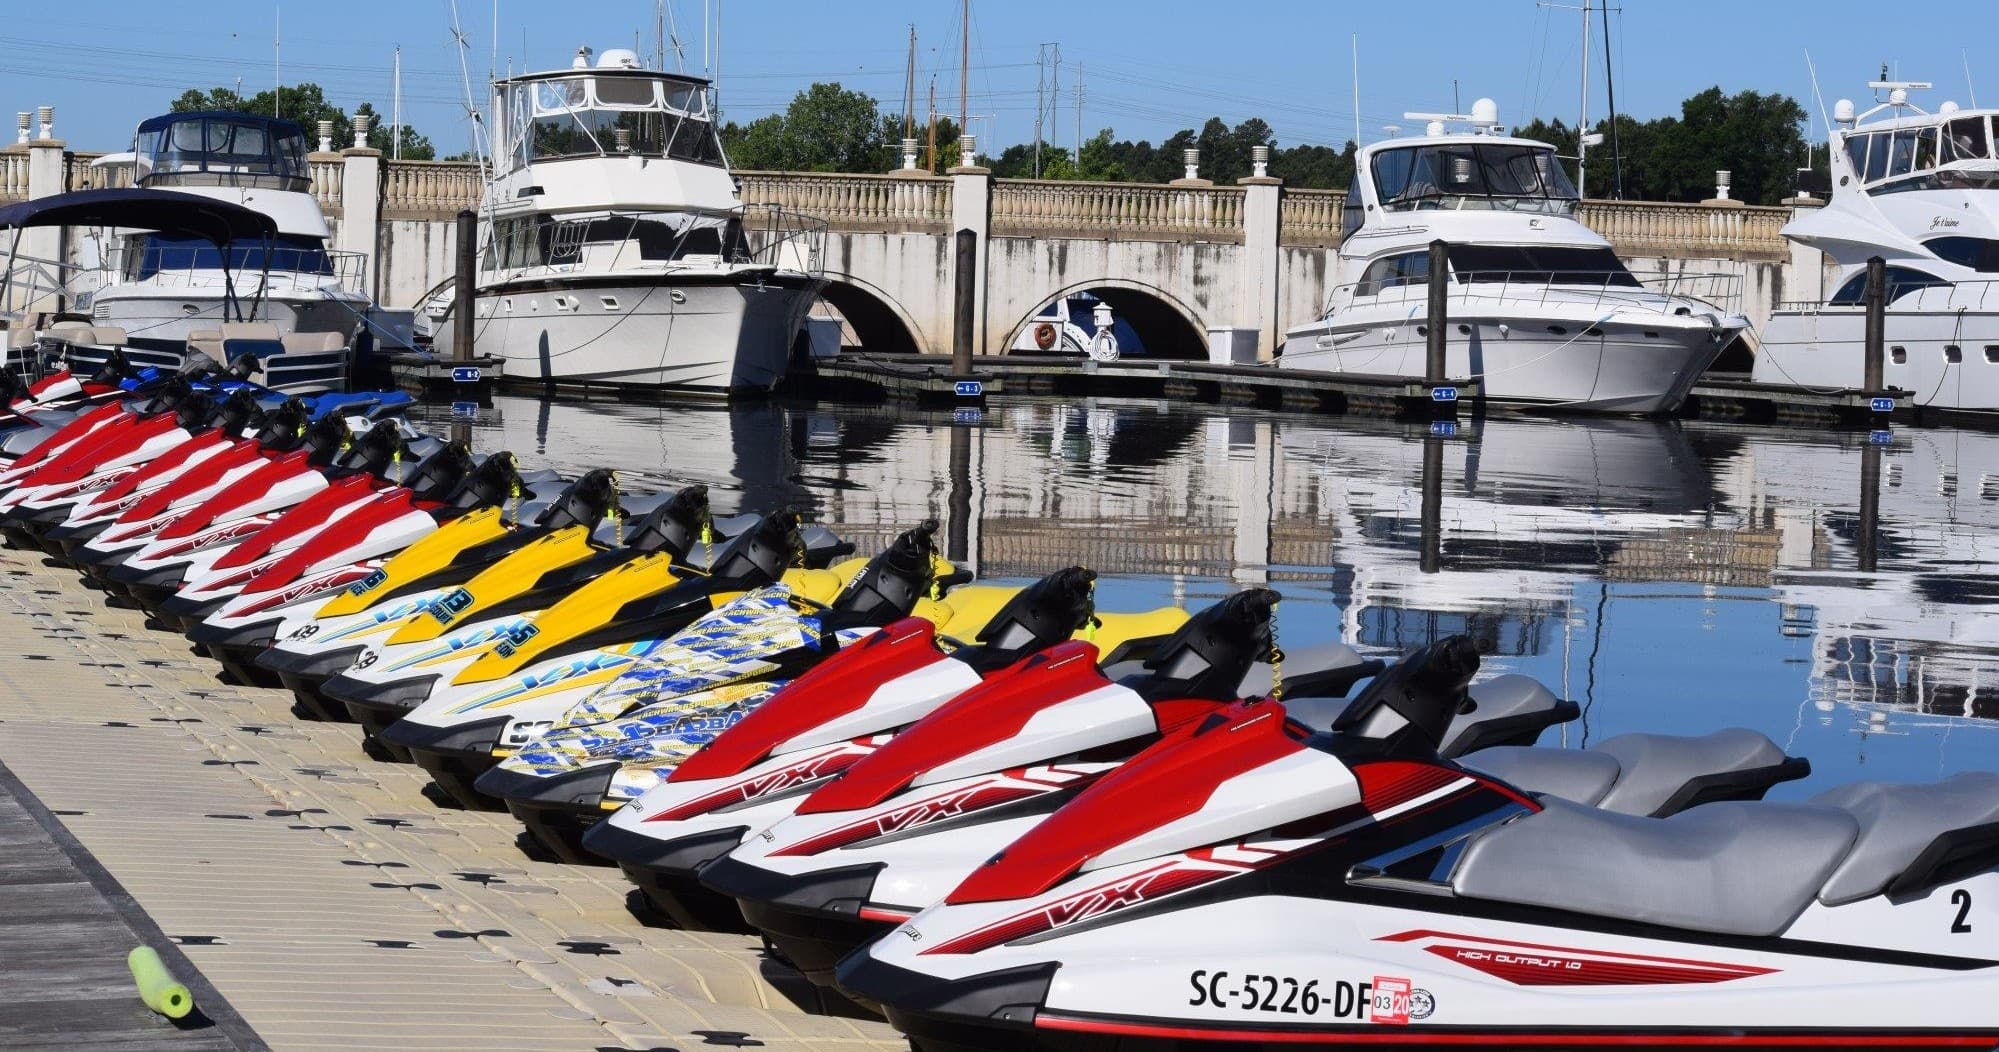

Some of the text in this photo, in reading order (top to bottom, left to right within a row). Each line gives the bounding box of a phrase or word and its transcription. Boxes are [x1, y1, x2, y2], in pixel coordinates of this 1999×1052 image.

[283, 574, 338, 604] VX
[741, 758, 828, 800] VX
[877, 790, 977, 836] VX
[1045, 873, 1162, 930] VX
[1950, 888, 1972, 933] 2
[1456, 950, 1491, 961] HIGH
[1495, 954, 1562, 968] OUTPUT
[1189, 969, 1372, 1020] SC-5226-DF
[1374, 995, 1391, 1010] 03
[1393, 993, 1410, 1016] 20
